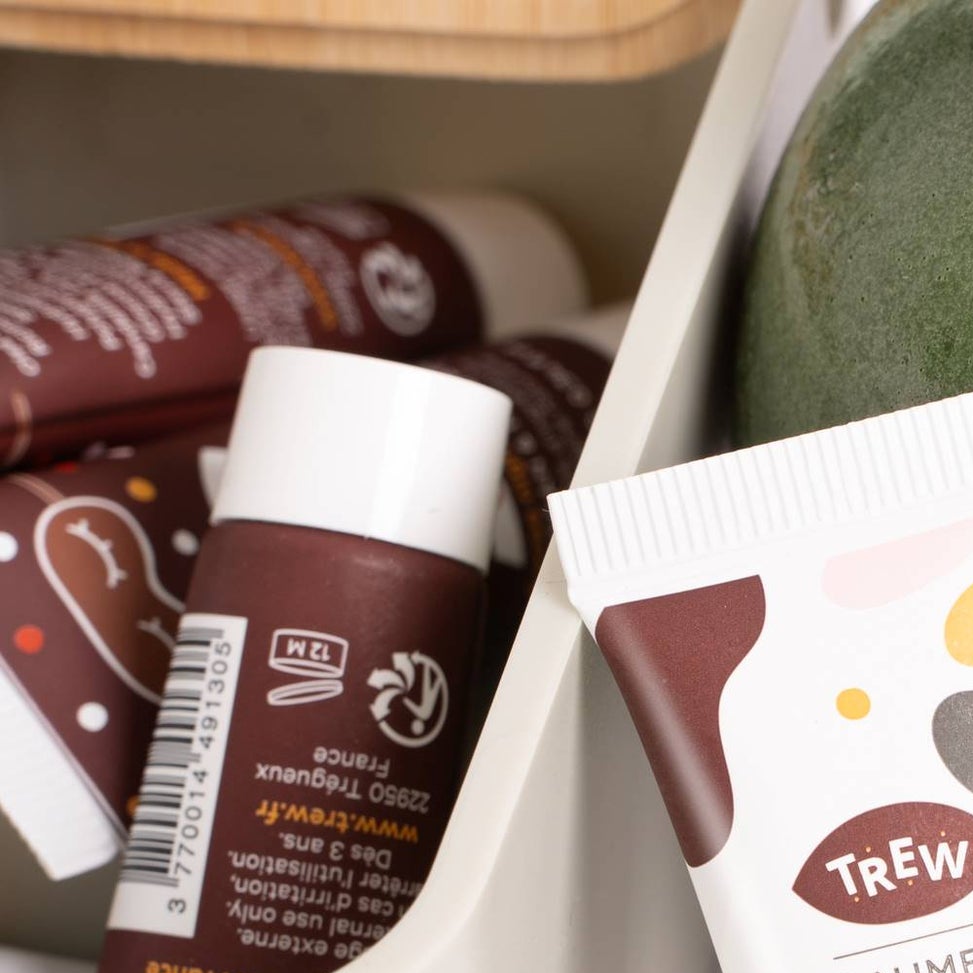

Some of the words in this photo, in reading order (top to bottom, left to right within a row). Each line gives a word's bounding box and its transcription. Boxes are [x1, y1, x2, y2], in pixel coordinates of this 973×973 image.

[286, 638, 306, 656] M
[309, 638, 332, 662] 12
[199, 641, 233, 751] 491305
[313, 747, 390, 778] France
[255, 763, 363, 801] Trégueux
[369, 781, 430, 813] 22950
[173, 768, 209, 879] 770014
[255, 801, 418, 842] www.trew.fr
[279, 832, 323, 852] ans.
[330, 840, 342, 861] 3
[352, 844, 391, 869] Dès
[228, 852, 353, 888] l'utilisation.
[826, 837, 968, 897] TREW
[167, 897, 188, 916] 3
[231, 873, 351, 913] d'irritation,
[358, 896, 393, 918] cas
[226, 900, 277, 929] only.
[280, 908, 323, 933] use
[238, 926, 327, 959] externe.
